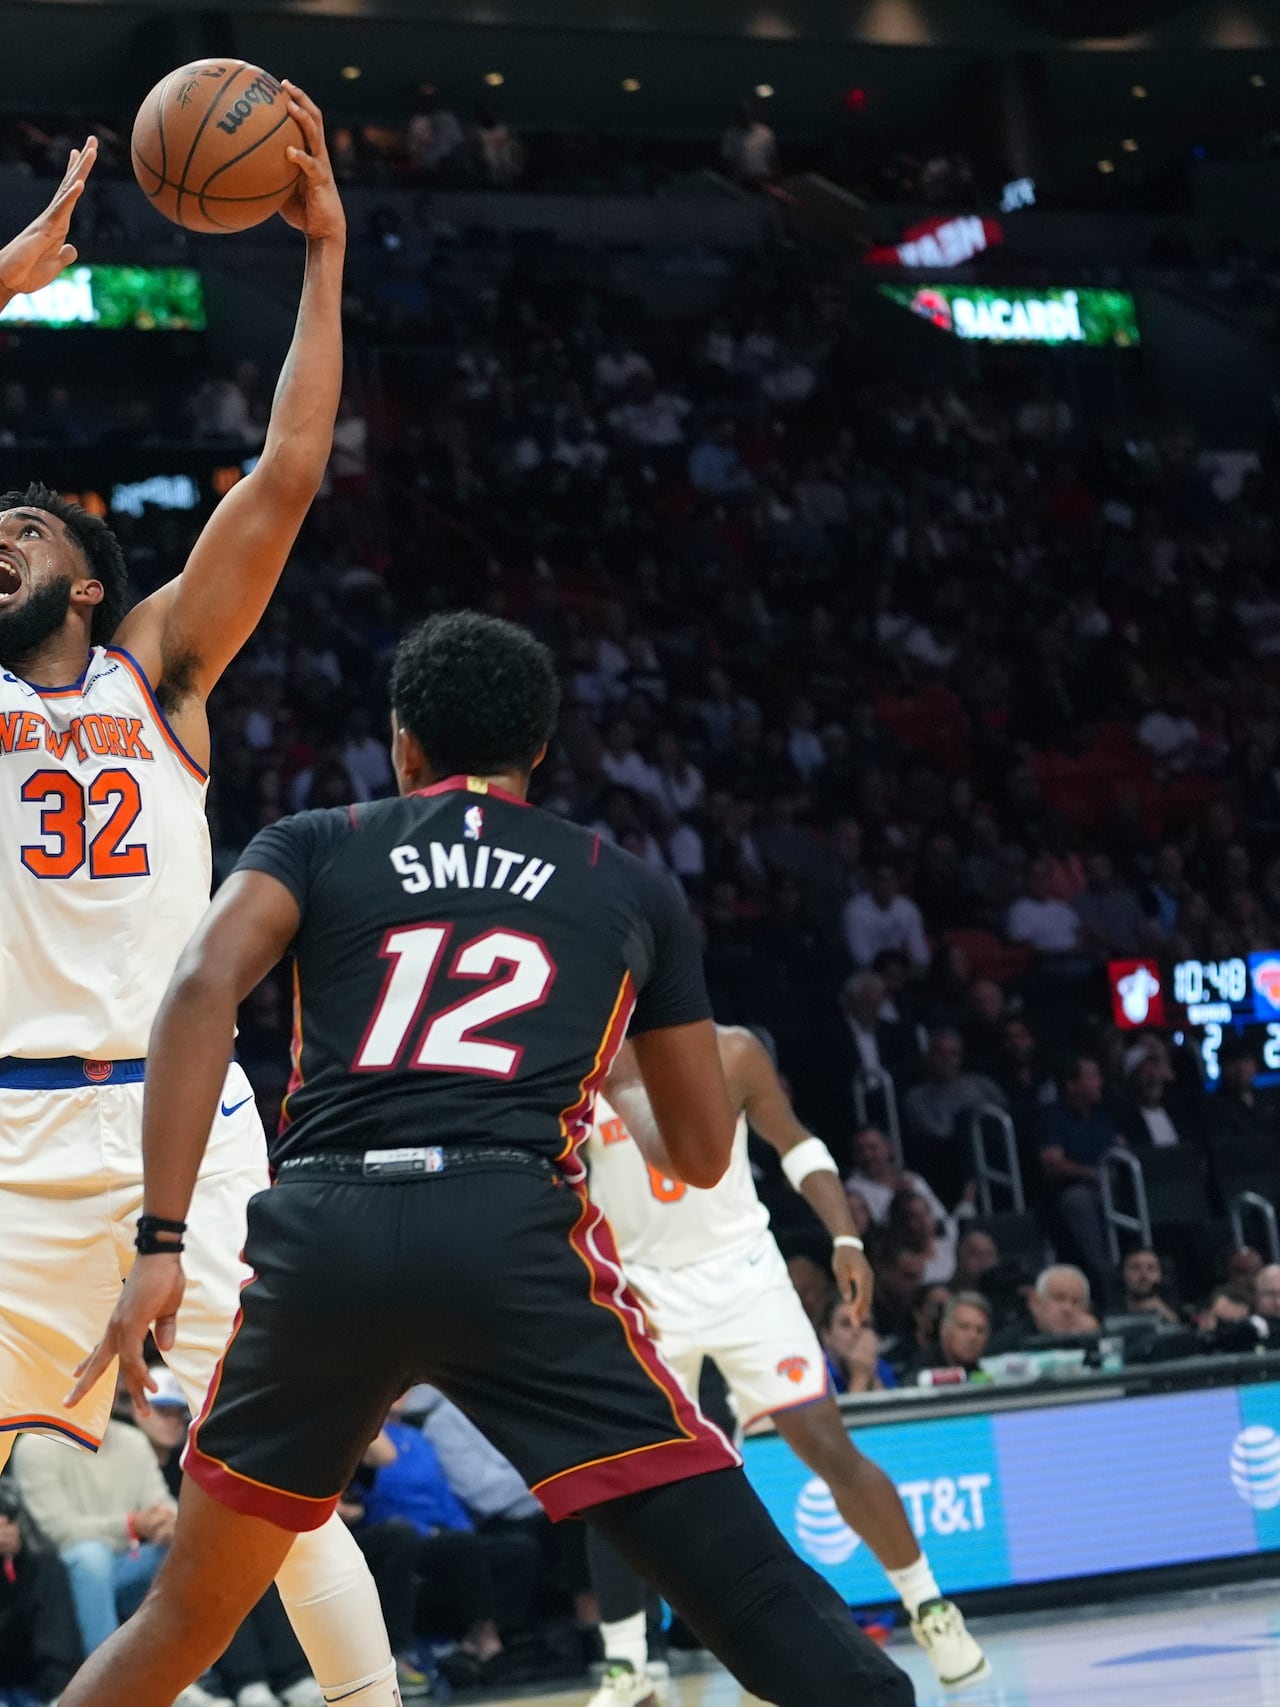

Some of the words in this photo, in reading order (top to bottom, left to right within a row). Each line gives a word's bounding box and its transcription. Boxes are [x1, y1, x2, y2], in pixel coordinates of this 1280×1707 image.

[70, 713, 156, 766] YORK
[20, 768, 151, 880] 32
[389, 841, 556, 901] SMITH
[349, 921, 558, 1081] 12
[1174, 958, 1247, 1004] 10:48
[896, 1473, 992, 1537] T&T
